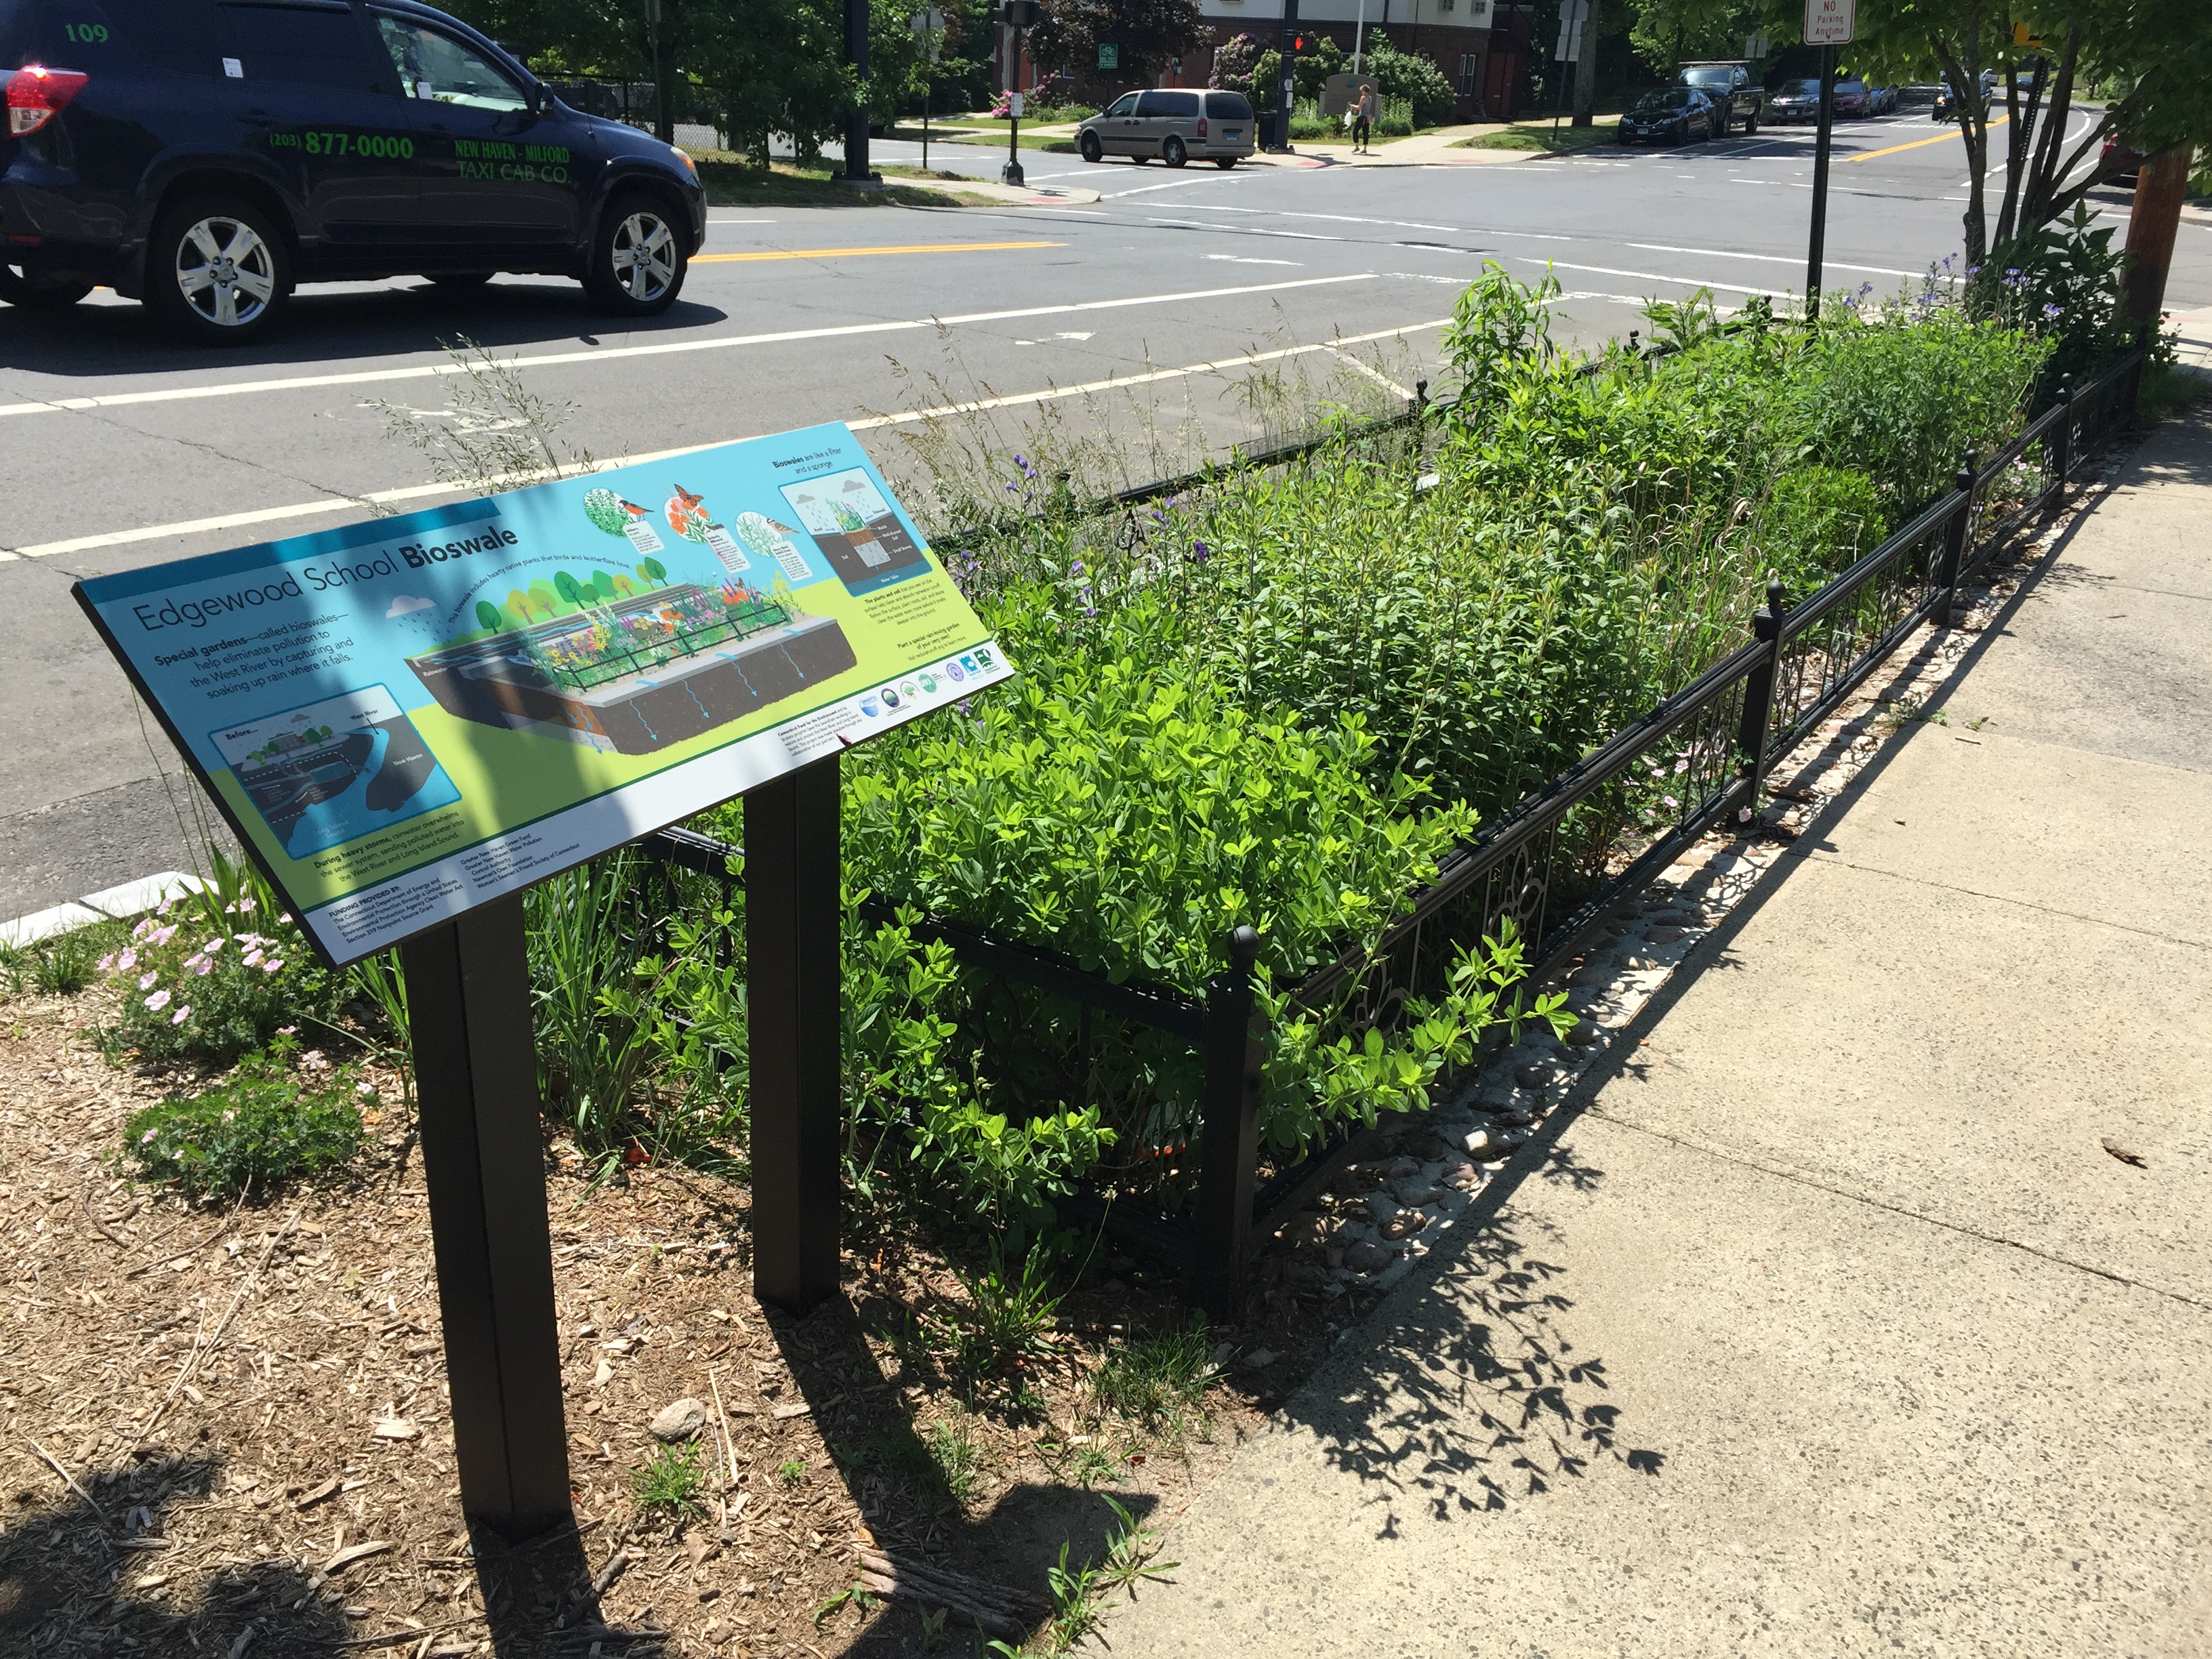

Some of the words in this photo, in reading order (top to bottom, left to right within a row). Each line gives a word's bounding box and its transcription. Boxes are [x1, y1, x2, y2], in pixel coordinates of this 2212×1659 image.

[1824, 1, 1836, 12] NO
[1817, 15, 1843, 24] Parking
[65, 23, 108, 43] 109
[1816, 27, 1844, 36] Anytime
[270, 134, 301, 149] (203)
[305, 131, 413, 159] 877-0000
[455, 140, 478, 158] NEW
[482, 142, 516, 160] HAVEN
[525, 144, 570, 163] MILFORD
[457, 161, 494, 180] TAXI
[500, 163, 535, 182] CAB
[541, 165, 571, 184] CO.
[772, 457, 804, 468] Bioswales
[505, 561, 523, 571] native
[523, 558, 540, 567] plants
[583, 554, 615, 565] butterflies
[134, 572, 302, 630] Edgewood
[304, 550, 398, 590] School
[400, 527, 517, 567] Bioswale
[487, 568, 506, 579] hearty
[468, 577, 489, 594] includes
[453, 592, 472, 613] bioswale
[449, 613, 459, 623] This
[155, 647, 198, 665] Special
[190, 677, 210, 687] the
[209, 668, 241, 681] West
[239, 661, 267, 674] River
[267, 657, 283, 666] by
[285, 644, 333, 661] capturing
[334, 636, 354, 649] and
[194, 658, 220, 670] help
[223, 647, 270, 663] eliminate
[272, 634, 317, 652] pollution
[207, 682, 250, 698] soaking
[250, 678, 266, 687] up
[266, 671, 287, 682] rain
[288, 663, 320, 676] where
[320, 659, 330, 667] it
[329, 653, 352, 664] falls.
[314, 855, 341, 868] During
[340, 847, 363, 858] heavy
[365, 837, 392, 850] storms,
[392, 825, 421, 839] rainwater
[422, 811, 459, 827] overwhelms
[333, 861, 352, 872] sewer
[354, 853, 380, 865] system,
[380, 842, 407, 855] sending
[407, 830, 433, 846] polluted
[433, 825, 451, 834] water
[460, 855, 478, 865] Greater
[490, 844, 505, 853] Haven
[518, 833, 531, 841] Fund
[350, 867, 370, 876] West
[369, 860, 386, 869] River
[388, 853, 401, 863] and
[400, 848, 419, 858] Long
[417, 840, 436, 851] Island
[436, 832, 459, 844] Sound.
[464, 861, 483, 870] Greater
[522, 837, 542, 847] Pollution
[507, 855, 533, 867] Foundation
[518, 861, 533, 871] Friend
[533, 857, 550, 865] Society
[554, 843, 579, 856] Connecticut
[471, 865, 489, 876] Control
[489, 857, 510, 868] Authority
[329, 902, 359, 917] FUNDING
[359, 889, 390, 905] PROVIDED
[337, 912, 374, 930] Environmental
[375, 902, 401, 915] Protection
[401, 893, 422, 904] through
[424, 884, 442, 895] United
[441, 879, 457, 888] States
[344, 904, 375, 919] Connecticut
[375, 892, 406, 907] Department
[411, 882, 430, 892] Energy
[342, 918, 379, 937] Environmental
[378, 908, 405, 921] Protection
[406, 901, 424, 910] Agency
[424, 895, 439, 903] Clean
[438, 888, 453, 897] Water
[346, 933, 366, 943] Section
[366, 927, 376, 935] 319
[376, 918, 401, 930] Nonpoint
[401, 911, 419, 920] Source
[419, 904, 434, 913] Grant
